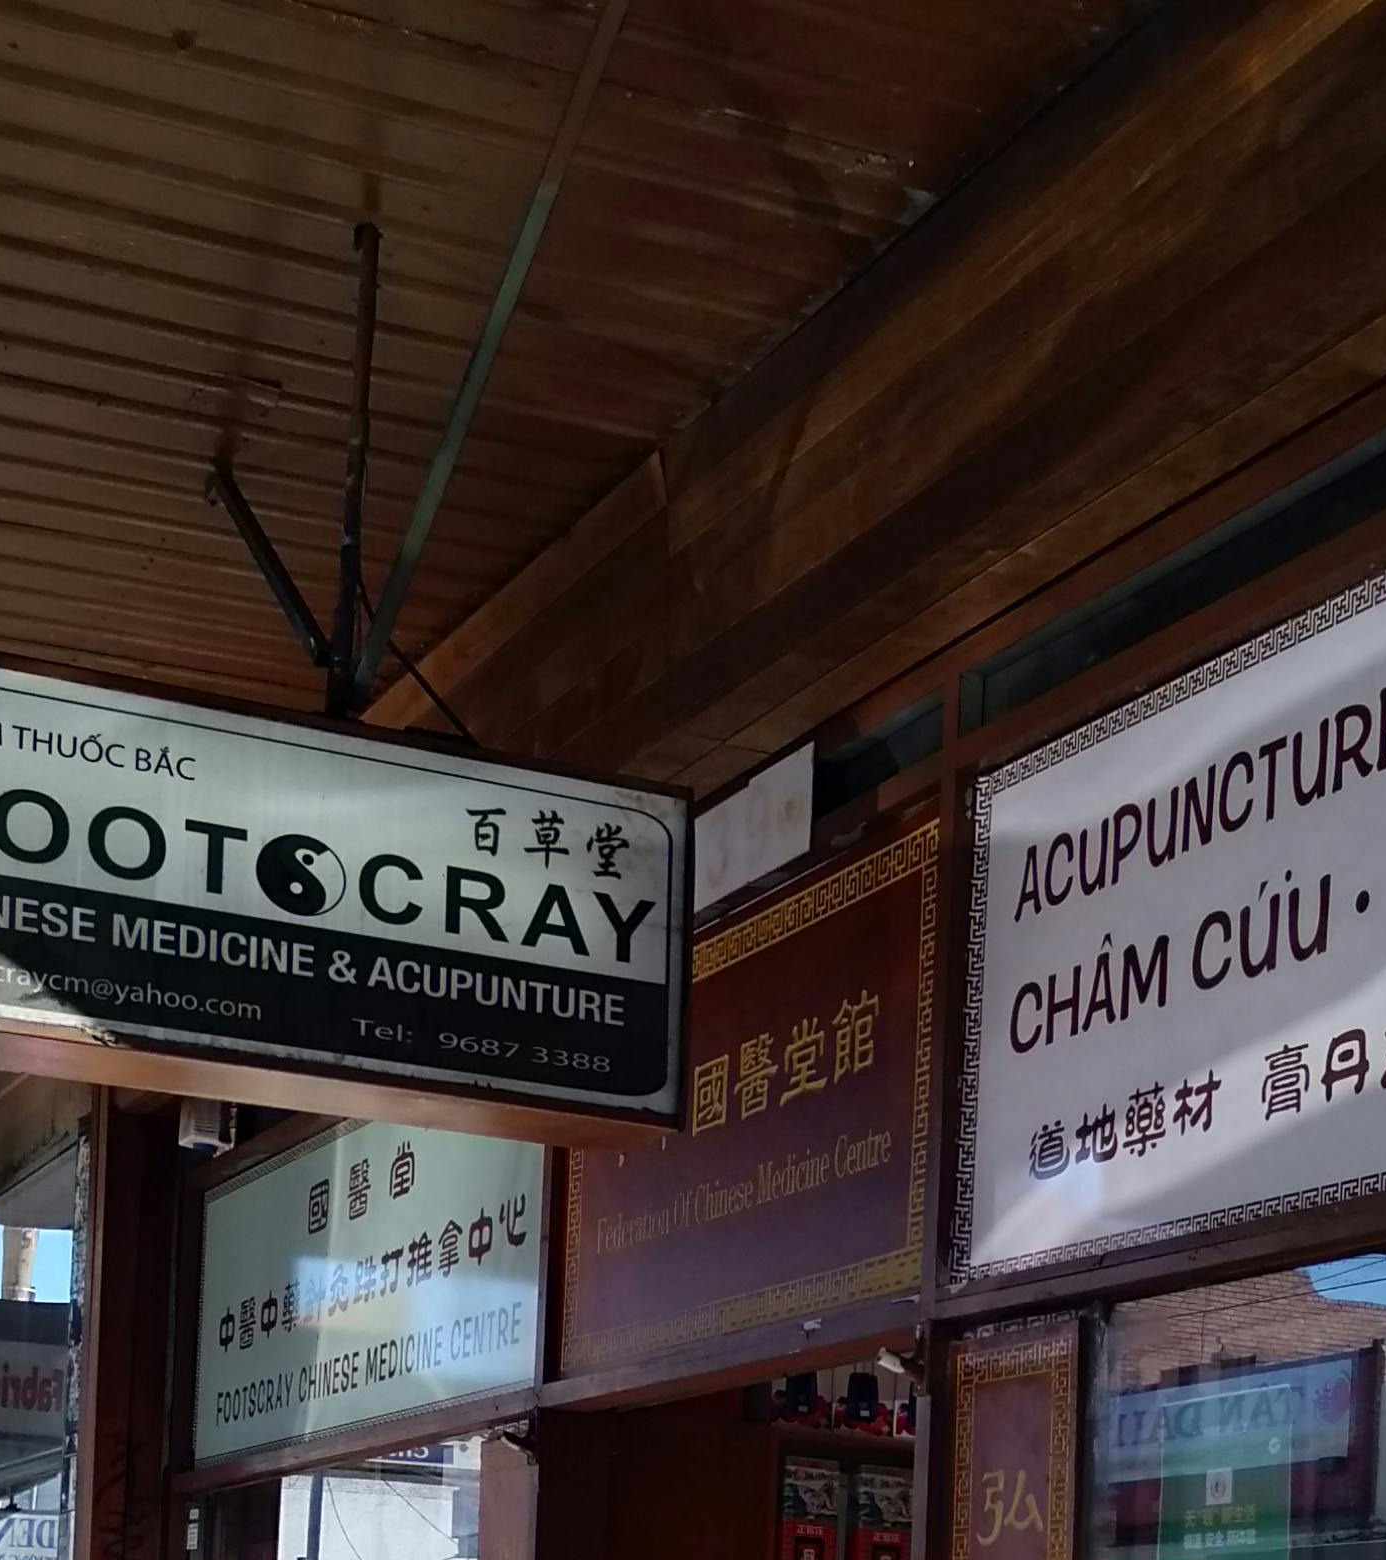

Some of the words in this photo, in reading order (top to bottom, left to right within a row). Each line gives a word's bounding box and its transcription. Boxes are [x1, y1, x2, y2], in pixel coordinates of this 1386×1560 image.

[11, 724, 126, 770] THUỐC
[133, 745, 197, 782] BẮC
[465, 806, 633, 882] 百草堂
[111, 911, 316, 979] MEDICINE
[327, 947, 357, 986] &
[368, 957, 627, 1028] ACUPUNTURE
[1009, 933, 1170, 1056] CHÂM
[352, 1016, 415, 1046] Tel:
[438, 1029, 520, 1062] 9687
[531, 1043, 613, 1074] 3388
[1028, 1070, 1222, 1181] 道地藥材
[695, 1177, 754, 1229] Chinese
[757, 1152, 830, 1201] Medicine
[834, 1132, 893, 1179] Centre
[215, 1370, 295, 1427] FOOTSCRAY
[298, 1348, 360, 1403] CHINESE
[364, 1325, 443, 1385] MEDICINE
[450, 1301, 521, 1363] CENTRE
